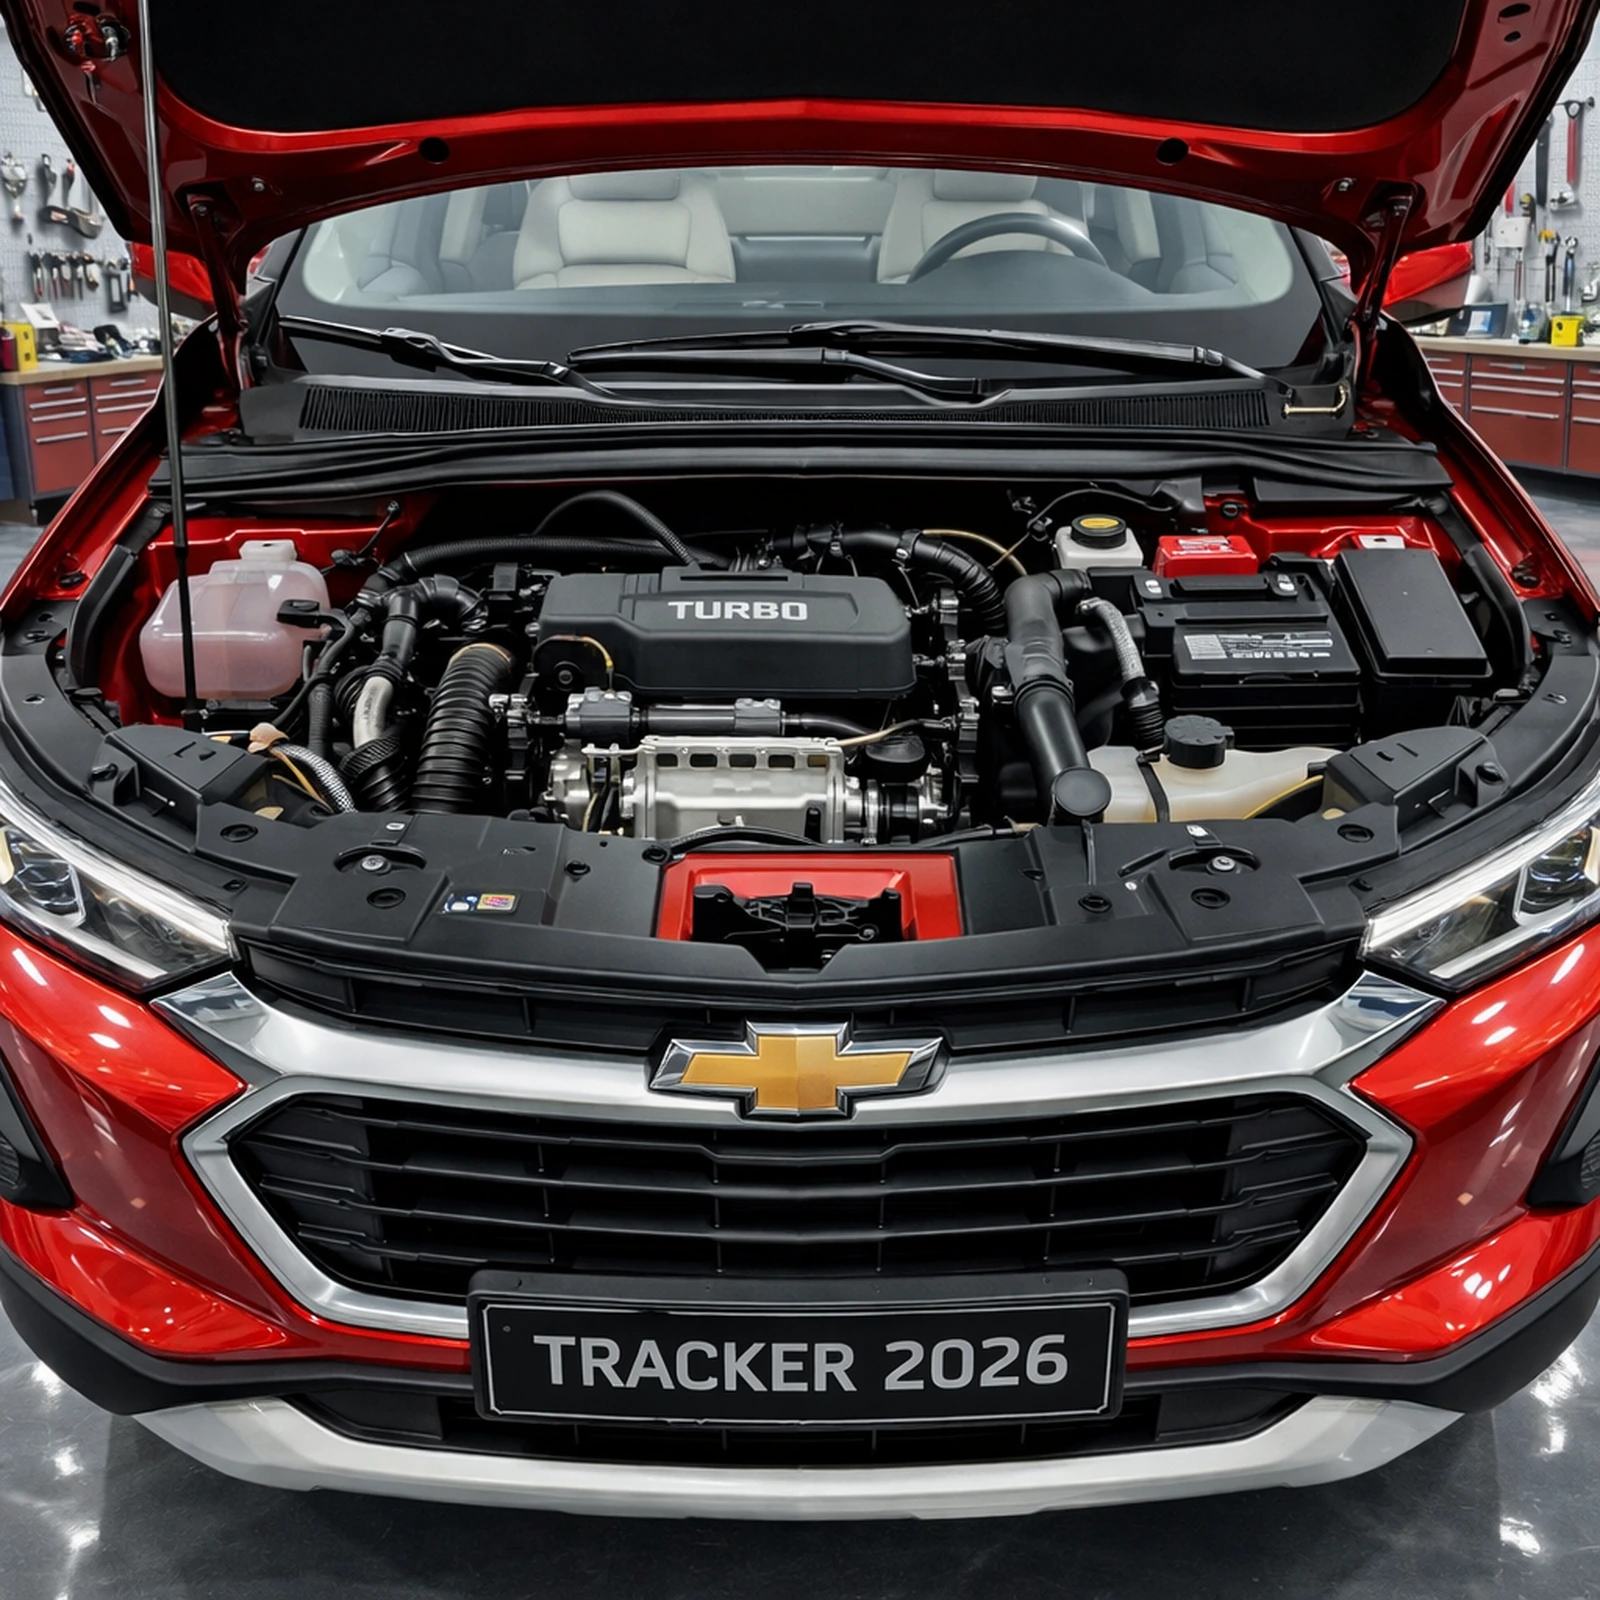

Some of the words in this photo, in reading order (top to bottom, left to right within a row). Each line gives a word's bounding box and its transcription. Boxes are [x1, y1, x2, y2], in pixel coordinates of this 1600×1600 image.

[667, 601, 808, 621] TURBO
[533, 1335, 857, 1392] TRACKER
[884, 1334, 1068, 1391] 2026
